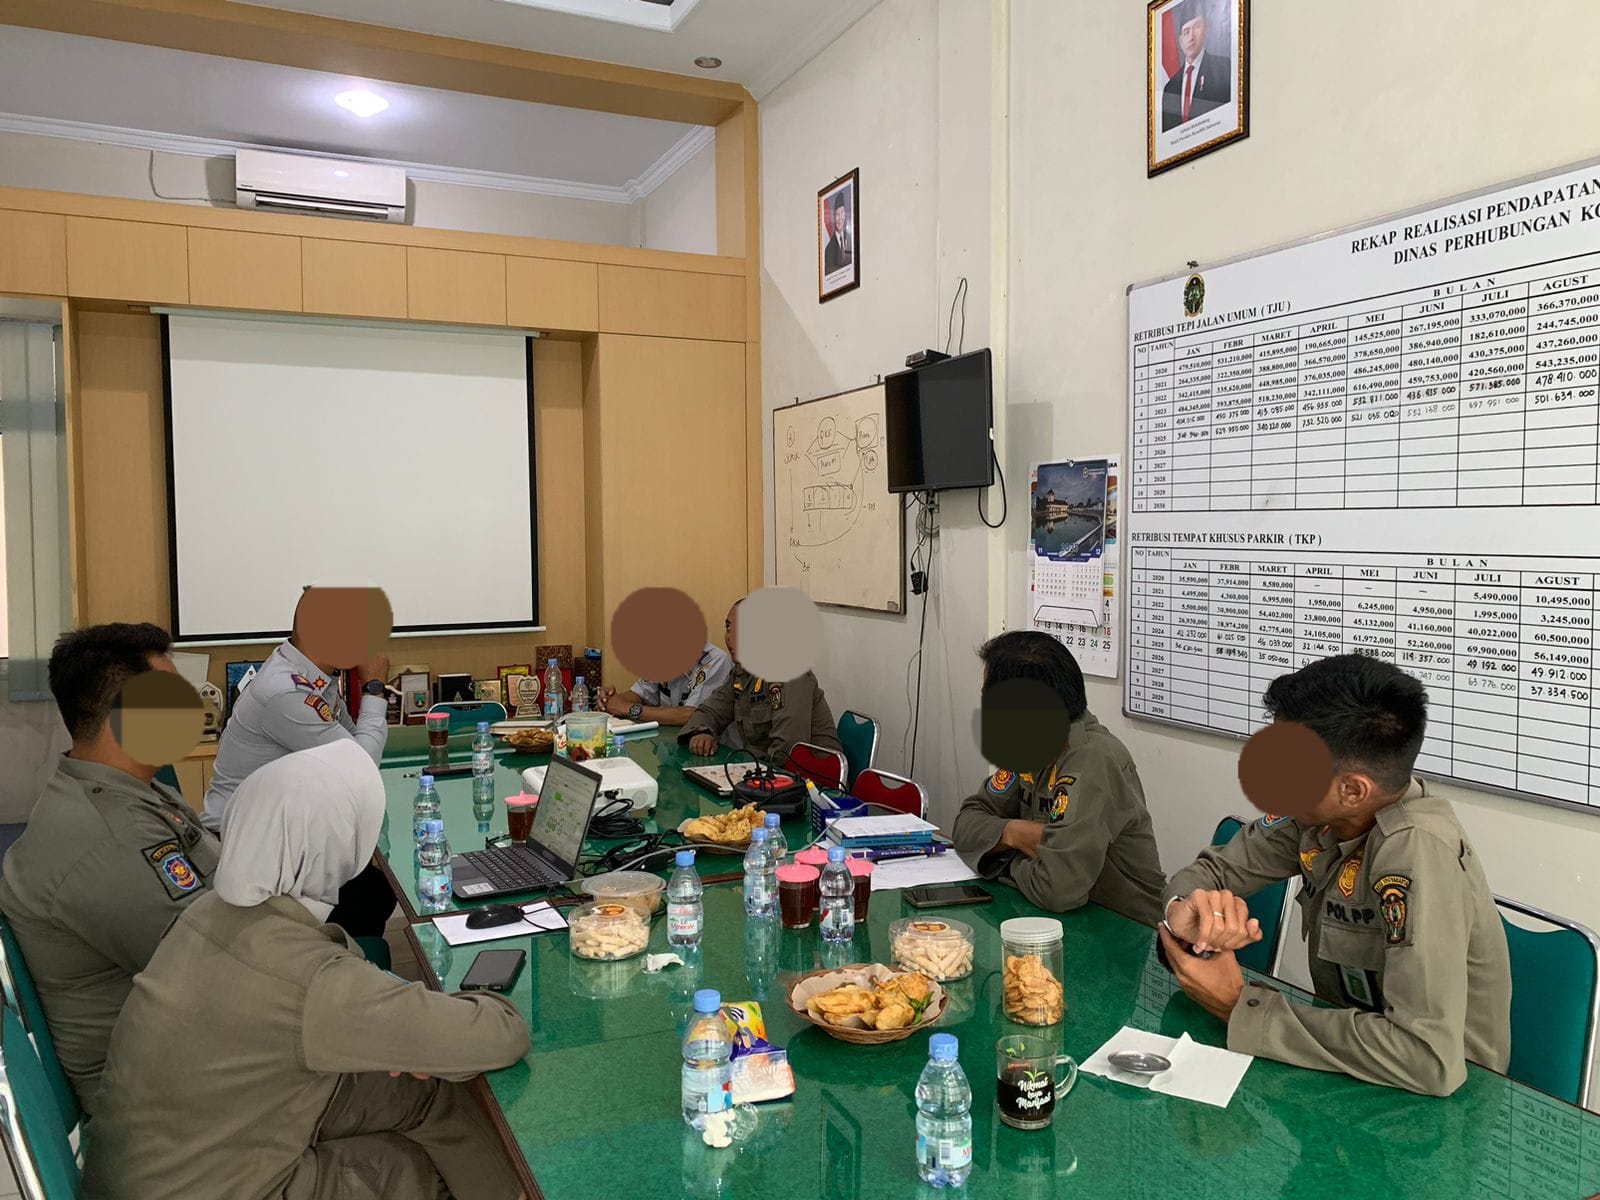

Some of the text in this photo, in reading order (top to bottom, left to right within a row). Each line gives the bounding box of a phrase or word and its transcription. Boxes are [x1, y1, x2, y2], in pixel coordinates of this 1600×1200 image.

[1352, 231, 1396, 254] REKAP
[1404, 208, 1482, 240] REALISASI
[1394, 243, 1437, 264] DINAS
[1445, 210, 1571, 252] PERHUBUNGAN
[1134, 324, 1173, 342] RETRIBUSI
[1176, 320, 1194, 333] TEPI
[1196, 313, 1224, 328] JALAN
[1227, 307, 1256, 322] UMUM
[1186, 274, 1588, 355] JAN FEBR MARET APRIL MEI JUNI JULI AGUST
[1304, 336, 1346, 351] 190,665,000
[1354, 327, 1400, 342] 145,525,000
[1408, 317, 1460, 333] 267,195,000
[1469, 305, 1526, 323] 333,070,000
[1536, 293, 1599, 312] 366,370,000
[1137, 341, 1173, 354] NO TAHUN
[1303, 352, 1346, 367] 366,570,000
[1353, 344, 1399, 359] 378,650,000
[1408, 335, 1459, 351] 386,940,000
[1469, 324, 1525, 341] 182,610,000
[1536, 312, 1599, 331] 244,745,000
[1303, 369, 1345, 382] 376,035,000
[1353, 361, 1399, 375] 486,245,000
[1407, 353, 1459, 368] 480,140,000
[1468, 343, 1525, 360] 430,375,000
[1535, 333, 1598, 350] 437,260,000
[1303, 385, 1345, 398] 342,111,000
[1352, 378, 1399, 392] 616,490,000
[1407, 371, 1458, 385] 459,753,000
[1467, 362, 1524, 378] 420,560,000
[1535, 353, 1597, 369] 543,235,000
[1131, 532, 1170, 541] RETRIBUSI
[1172, 532, 1206, 542] TEMPAT
[1209, 533, 1245, 543] KHUSUS
[1247, 533, 1284, 543] PARKIR
[1360, 569, 1378, 577] MEI
[1413, 571, 1437, 579] JUNI
[1474, 573, 1500, 582] JULI
[1535, 575, 1579, 585] AGUST
[1105, 600, 1110, 608] 4
[1308, 598, 1341, 608] 1,950,000
[1357, 601, 1394, 612] 6,245,000
[1412, 605, 1453, 616] 4,950,000
[1474, 609, 1517, 621] 1,995,000
[1540, 614, 1590, 626] 3,245,000
[1473, 592, 1518, 602] 5,490,000
[1536, 595, 1590, 607] 10,495,000
[1104, 614, 1110, 622] 11
[1104, 627, 1111, 636] 18
[1352, 617, 1394, 629] 45,132,000
[1407, 622, 1452, 634] 41,160,000
[1467, 627, 1517, 639] 40,022,000
[1534, 632, 1590, 646] 60,500,000
[1066, 636, 1111, 650] 22 23 24 25
[1303, 629, 1341, 640] 24,105,000
[1352, 633, 1393, 645] 61,972,000
[1407, 639, 1452, 651] 52,260,000
[1466, 644, 1517, 658] 69,900,000
[1533, 651, 1589, 665] 56,149,000
[1326, 901, 1376, 925] POL PP
[1018, 1076, 1048, 1092] Nikmat
